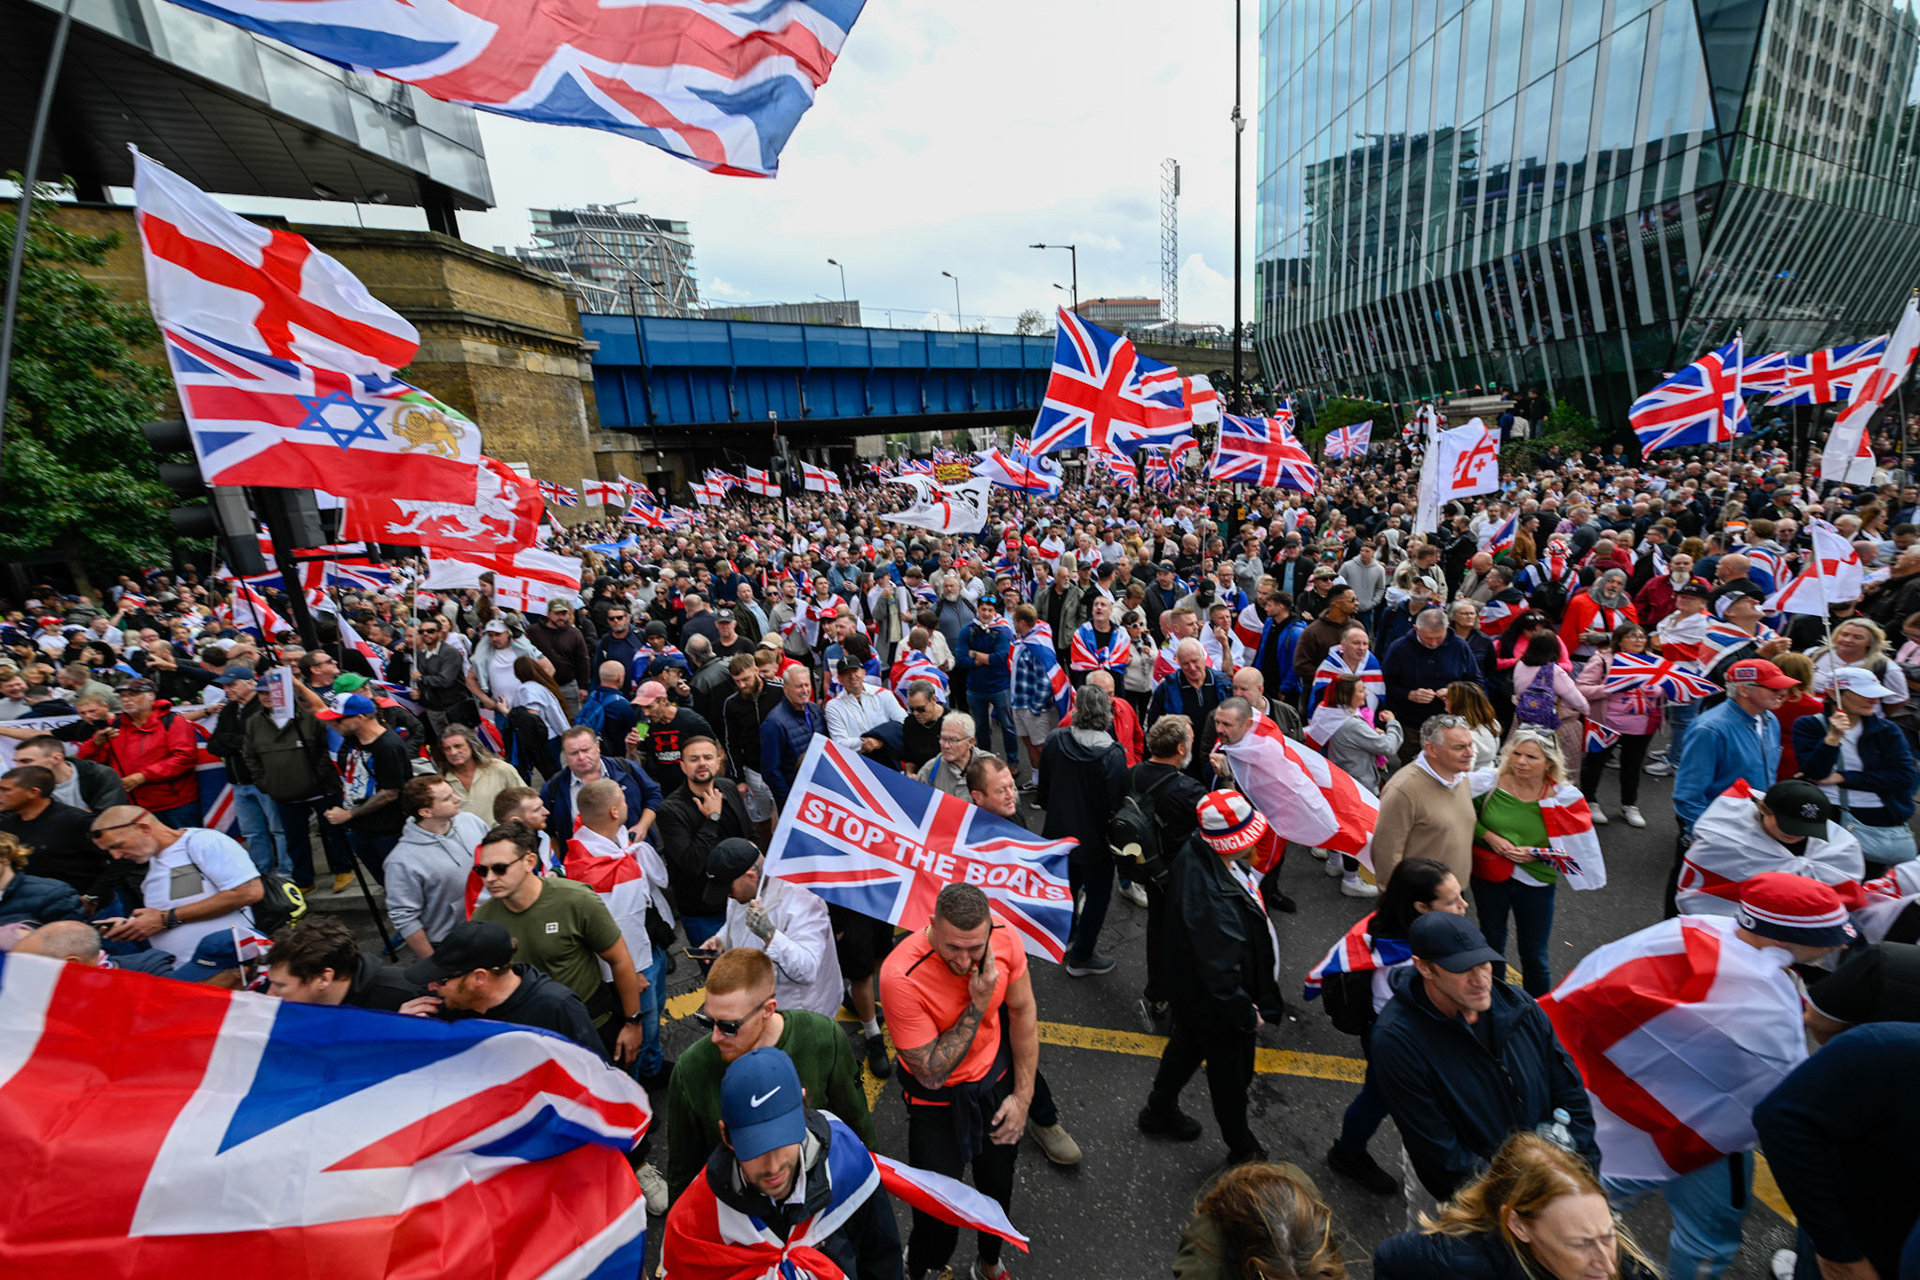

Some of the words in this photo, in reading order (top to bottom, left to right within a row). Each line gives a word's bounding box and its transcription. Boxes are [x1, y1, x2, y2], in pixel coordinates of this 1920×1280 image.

[804, 799, 885, 849] STOP
[893, 836, 957, 879] THE
[964, 862, 1067, 900] BOATS
[1212, 819, 1264, 852] ENGLAND
